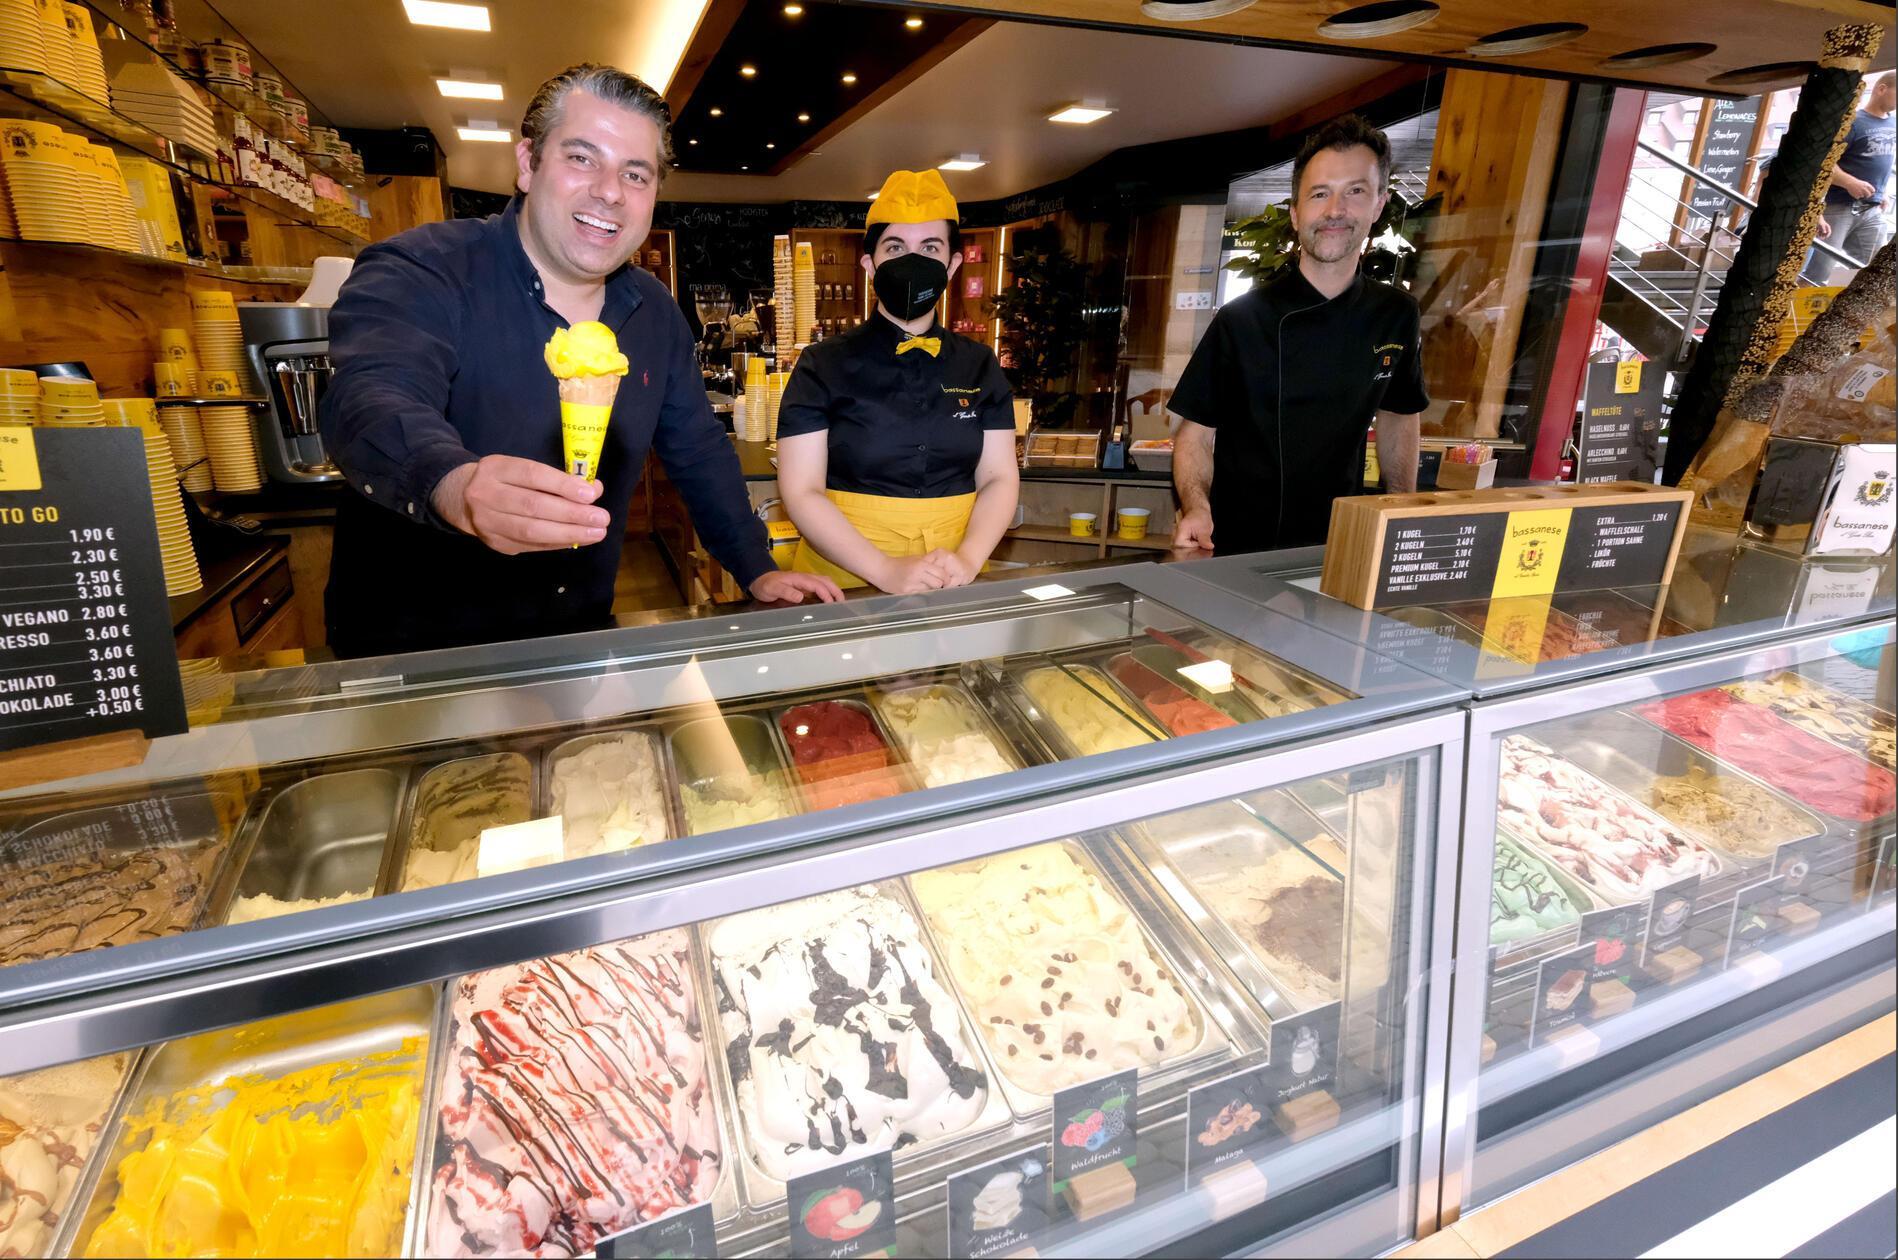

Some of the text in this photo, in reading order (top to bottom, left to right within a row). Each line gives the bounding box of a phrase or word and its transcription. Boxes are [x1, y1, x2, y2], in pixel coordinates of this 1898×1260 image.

[0, 506, 59, 524] TO GO
[1597, 516, 1615, 525] EXTRA
[1834, 515, 1889, 530] bassanese
[69, 527, 115, 543] 1.90 €
[1397, 531, 1401, 539] 1
[1402, 529, 1421, 539] KUGEL
[1512, 525, 1562, 538] bassanese
[1395, 542, 1399, 550] 2
[1400, 541, 1425, 550] KUGELN
[1602, 537, 1625, 547] PORTION
[1625, 535, 1644, 545] SAHNE
[72, 548, 118, 564] 2.30 €
[1393, 554, 1397, 562] 3
[1398, 552, 1423, 561] KUGELN
[1591, 558, 1616, 568] FRÜCHTE
[1391, 563, 1419, 573] PREMIUM
[1420, 562, 1439, 571] KUGEL
[75, 569, 122, 585] 2.50 €
[1389, 574, 1414, 584] VANILLE
[1415, 572, 1448, 582] EXKLUSIVE
[78, 583, 124, 599] 3.30 €
[2, 604, 128, 627] VEGANO 2.80 €
[85, 625, 119, 641] 3.60
[122, 624, 132, 637] €
[89, 644, 135, 661] 3.60 €
[92, 666, 126, 681] 3.30
[129, 665, 138, 677] €
[96, 686, 129, 702] 3.00
[132, 684, 141, 697] €
[86, 698, 144, 717] +0.50 €
[1071, 1147, 1122, 1171] Waldfrucht
[1214, 1148, 1244, 1165] Malaga
[830, 1240, 860, 1259] Apfel
[969, 1232, 1029, 1259] Schokolade
